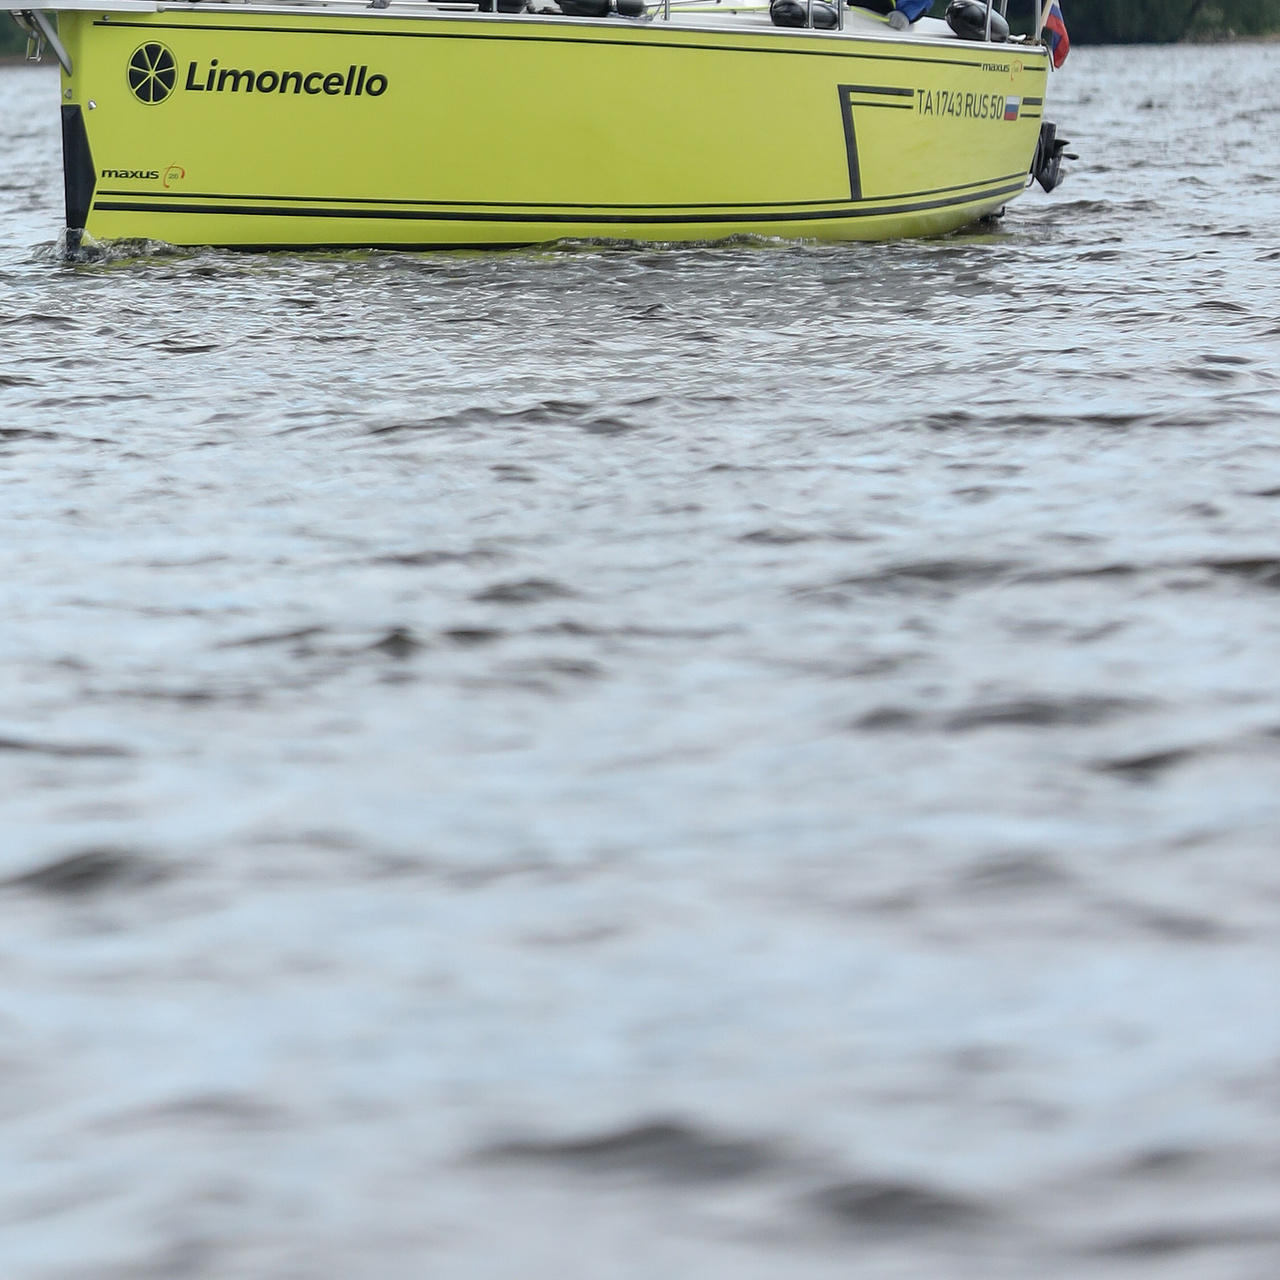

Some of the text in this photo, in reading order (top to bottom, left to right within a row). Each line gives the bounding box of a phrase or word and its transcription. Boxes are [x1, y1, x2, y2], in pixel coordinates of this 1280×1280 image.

[982, 63, 1010, 72] maxus
[185, 58, 388, 96] Limoncello
[101, 169, 160, 180] maxus
